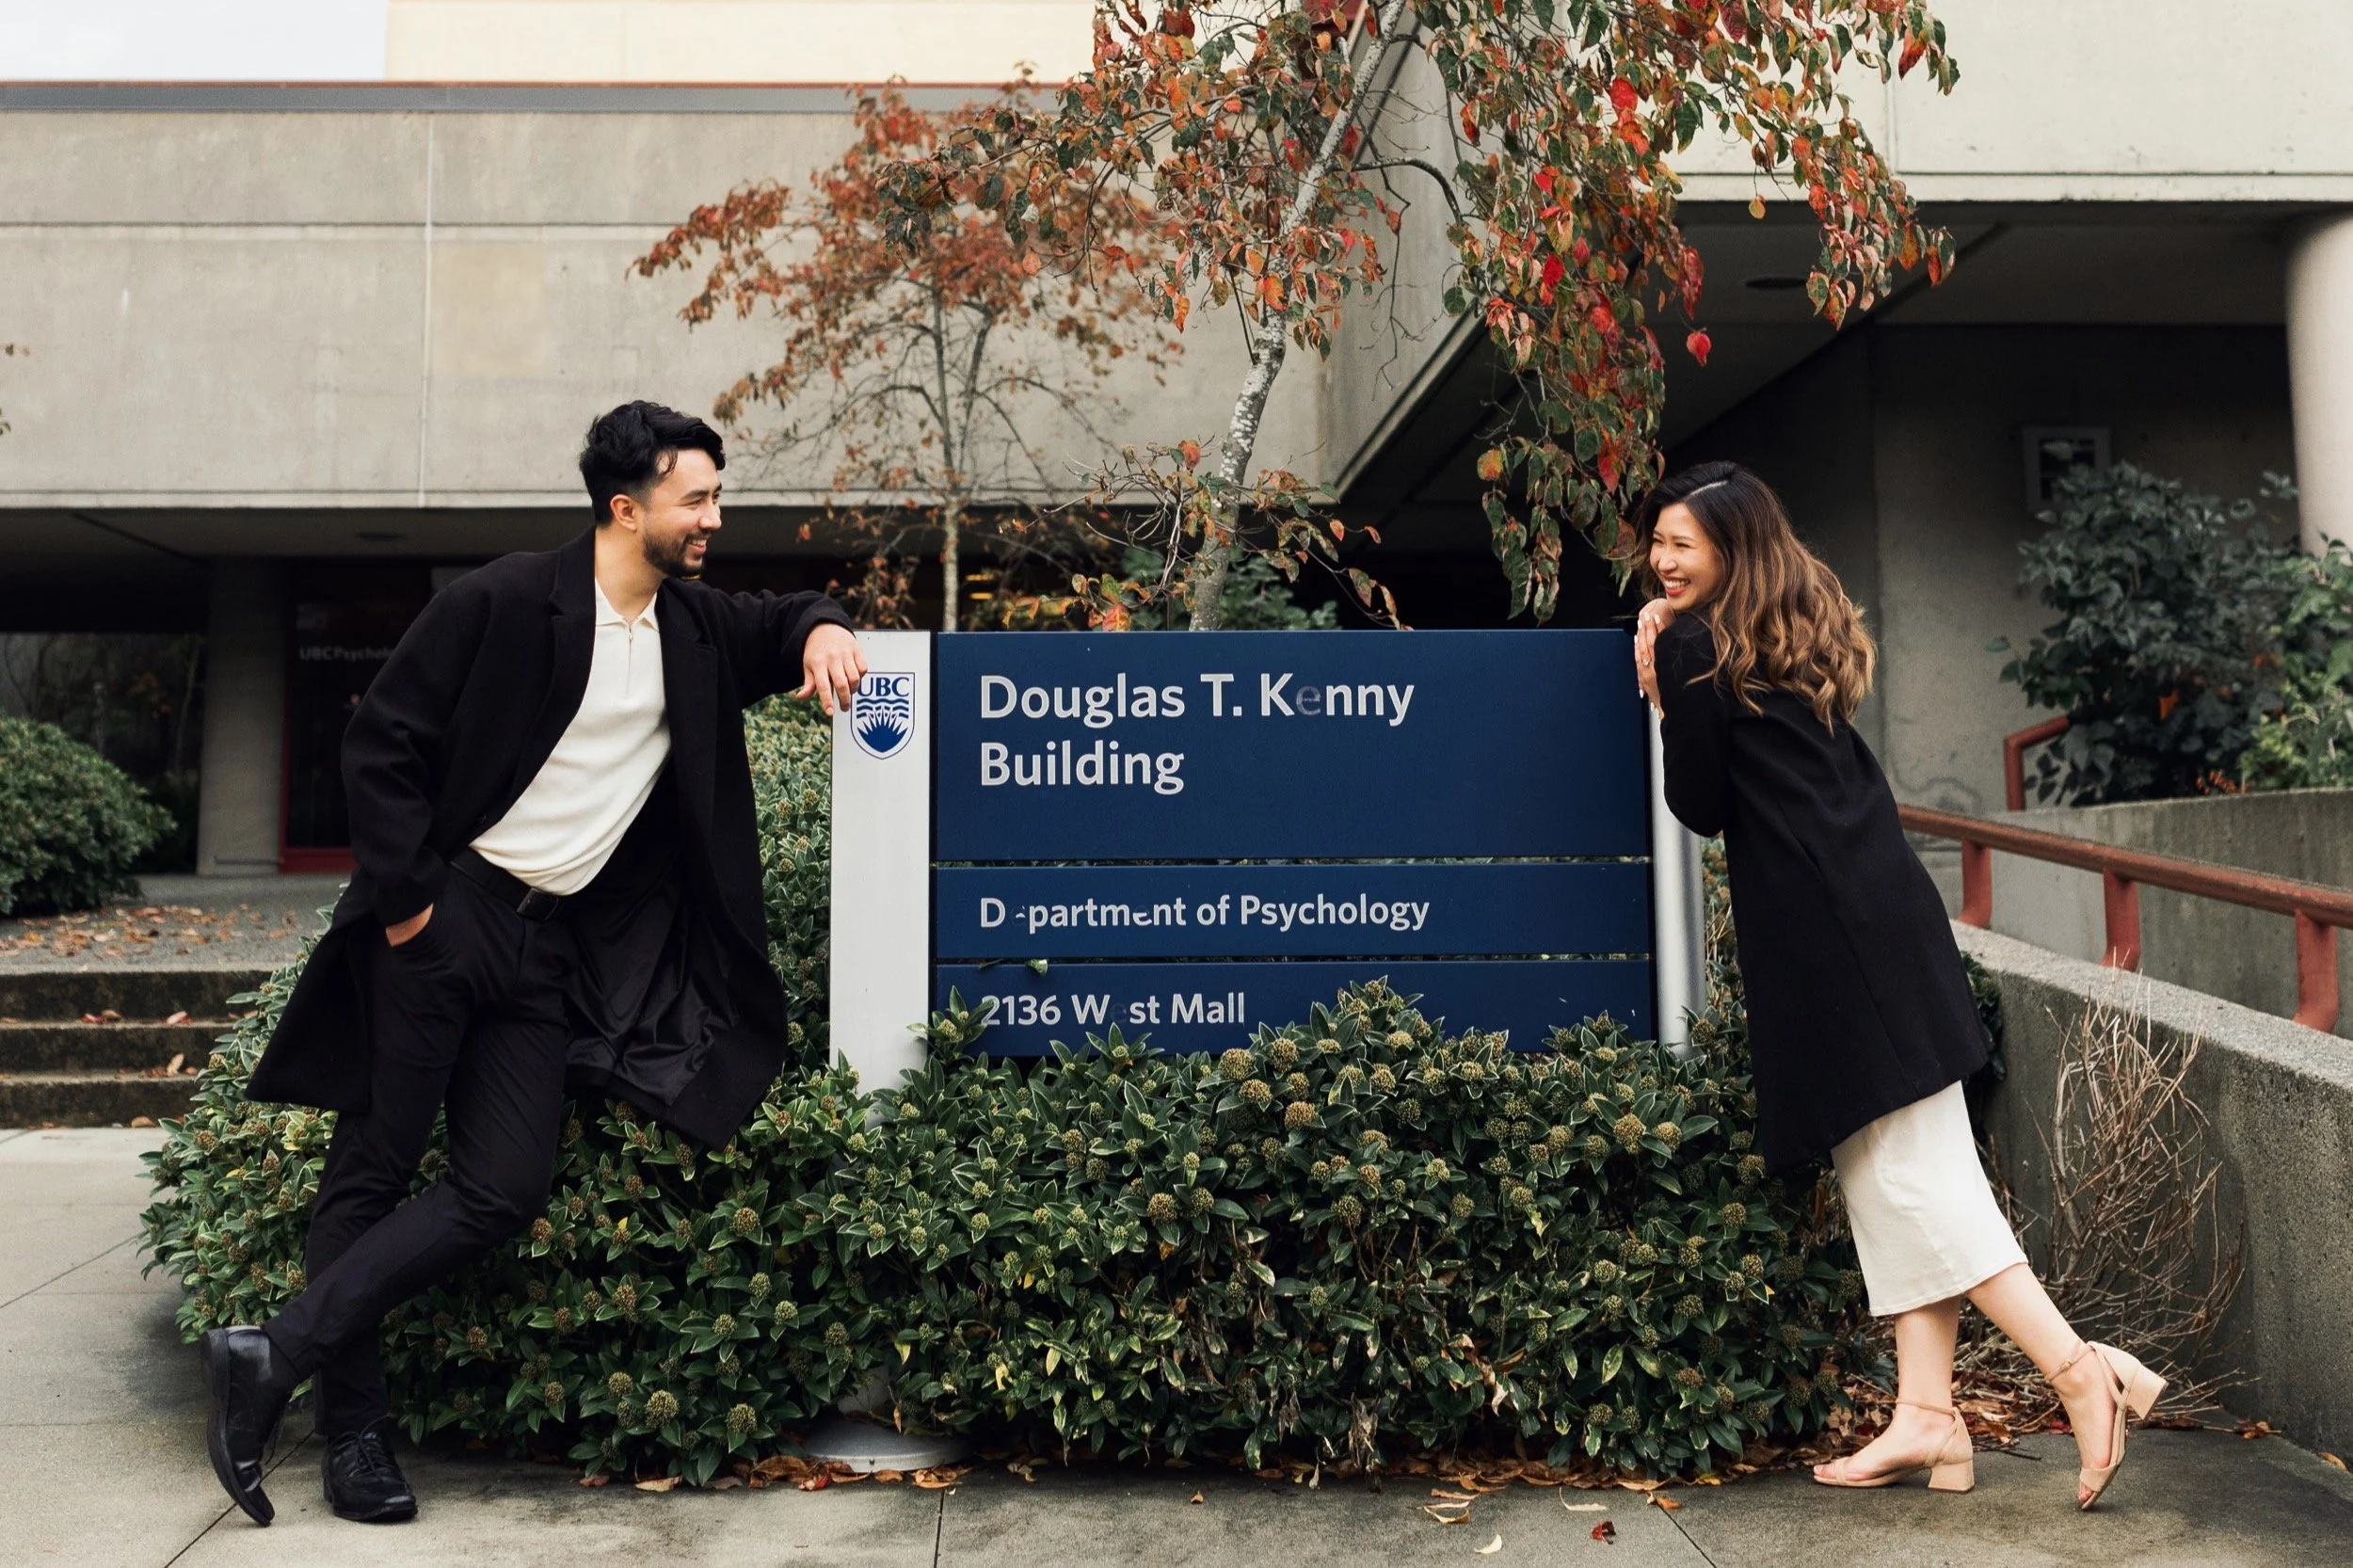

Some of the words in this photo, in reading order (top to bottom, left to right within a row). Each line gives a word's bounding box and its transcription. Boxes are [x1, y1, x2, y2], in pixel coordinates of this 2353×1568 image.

[857, 675, 911, 697] UBC
[981, 672, 1186, 728] Douglas
[1200, 673, 1242, 717] T.
[1260, 672, 1416, 727] Kenny
[981, 739, 1185, 795] Building
[980, 896, 1187, 935] Dpartment
[1195, 893, 1231, 926] of
[1240, 892, 1431, 932] Psychology
[980, 994, 1062, 1027] 2136
[1070, 993, 1160, 1026] Wst
[1170, 991, 1245, 1025] Mall
